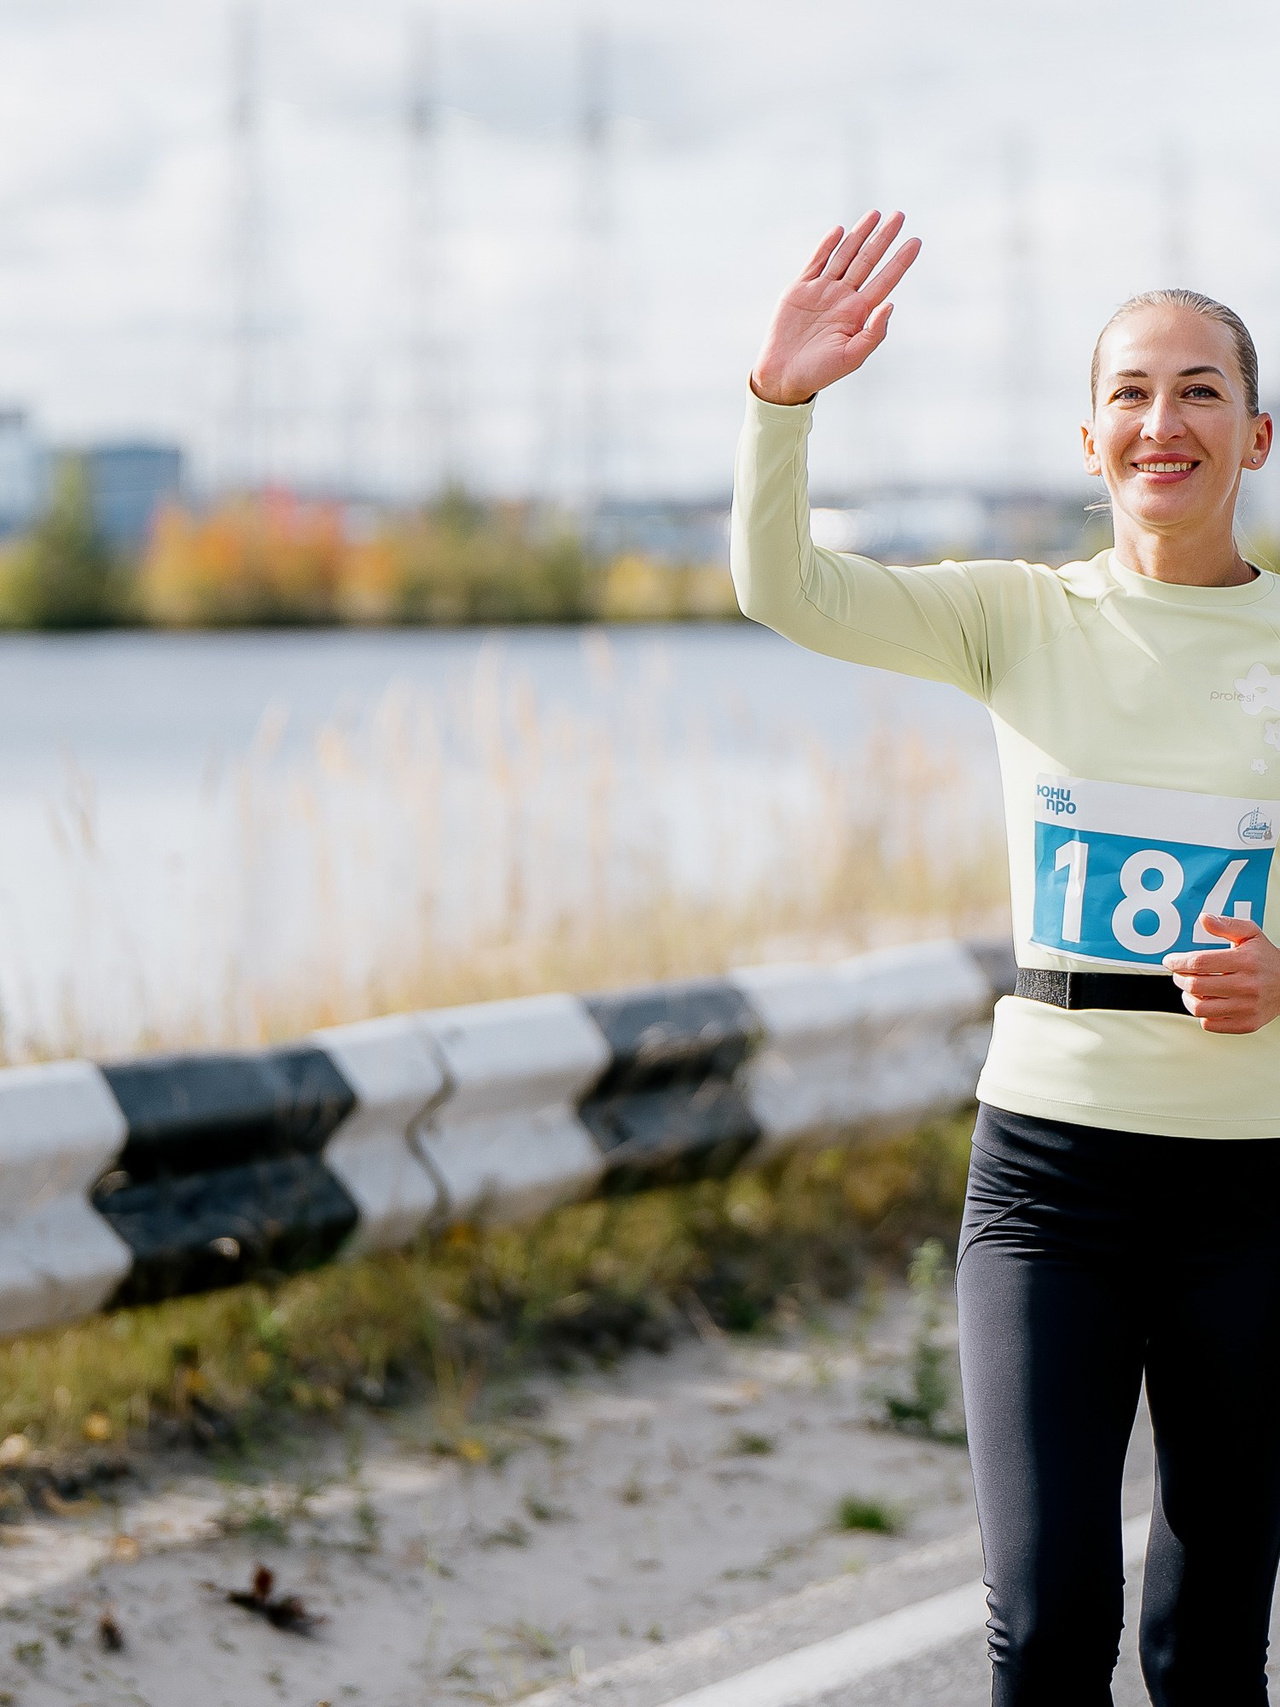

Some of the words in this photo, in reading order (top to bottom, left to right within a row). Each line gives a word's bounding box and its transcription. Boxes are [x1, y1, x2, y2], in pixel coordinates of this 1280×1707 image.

[1210, 691, 1256, 703] protest
[1046, 798, 1077, 815] про
[1054, 839, 1252, 955] 184
